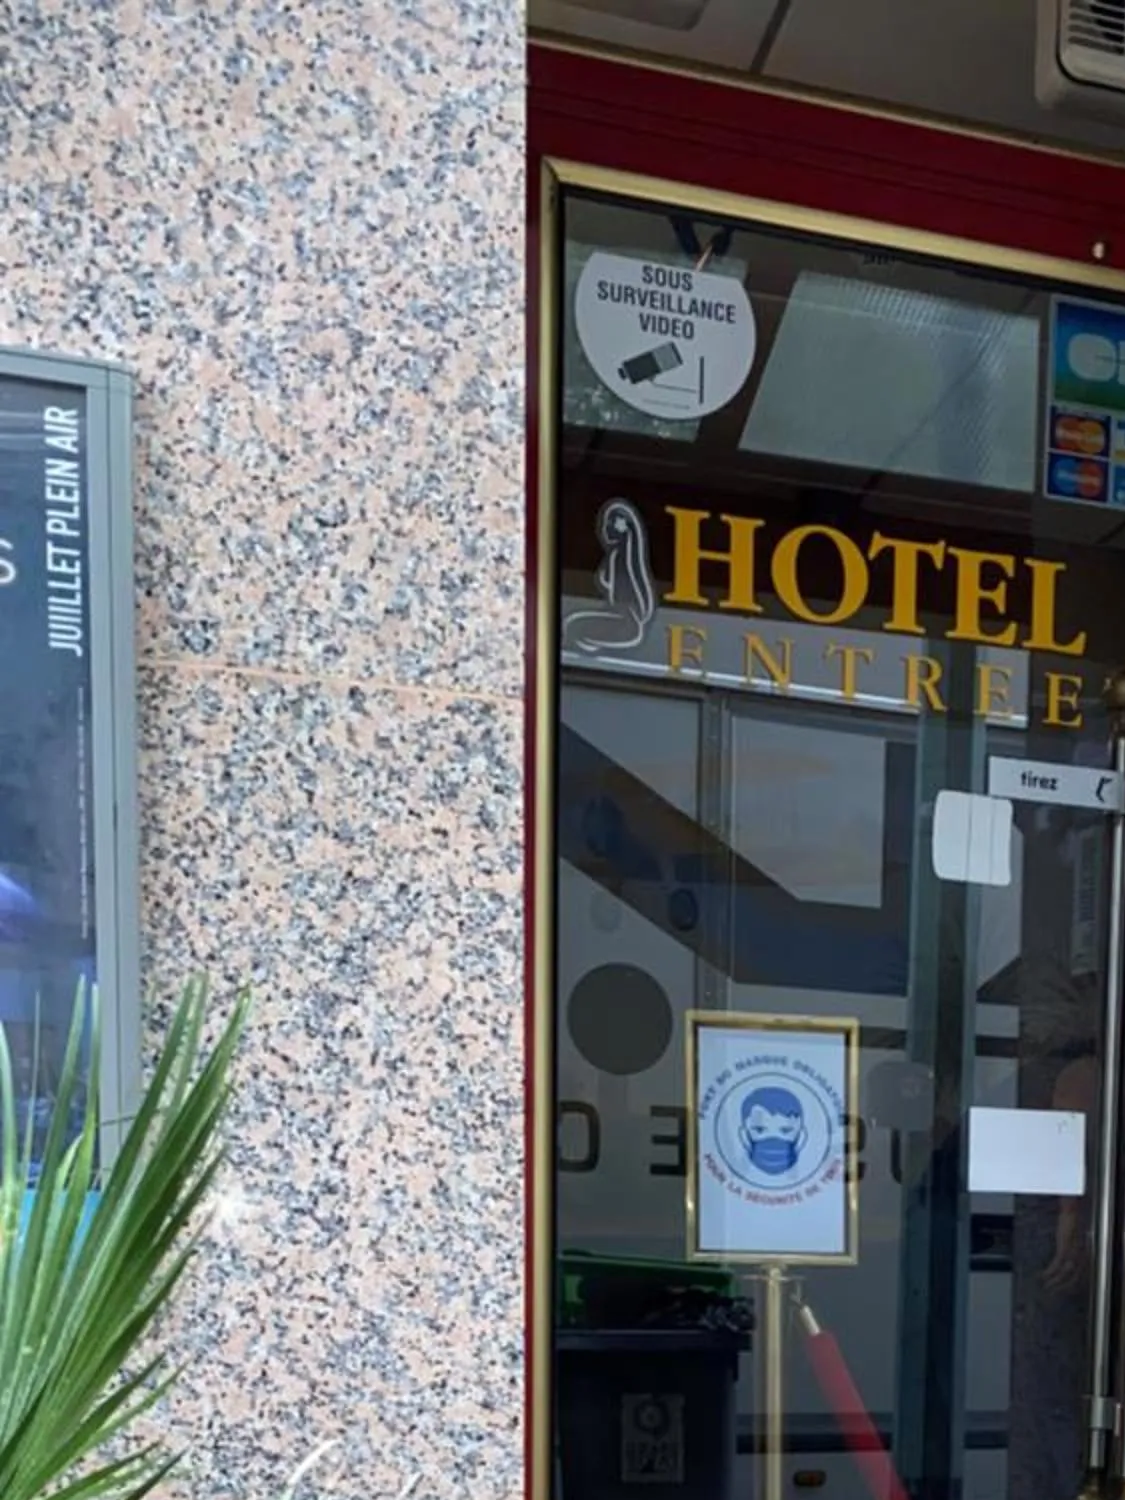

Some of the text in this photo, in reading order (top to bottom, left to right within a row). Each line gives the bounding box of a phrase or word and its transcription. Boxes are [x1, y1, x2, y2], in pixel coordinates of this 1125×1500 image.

[641, 265, 693, 292] SOUS
[597, 280, 736, 324] SURVEILLANCE
[638, 312, 695, 340] VIDEO
[44, 406, 79, 454] AIR
[45, 459, 80, 537] PLEIN
[663, 505, 1087, 656] HOTEL
[666, 624, 1084, 729] ENTREE
[1020, 771, 1058, 792] tirez
[735, 1055, 788, 1071] MASQUE
[727, 1176, 742, 1196] LA
